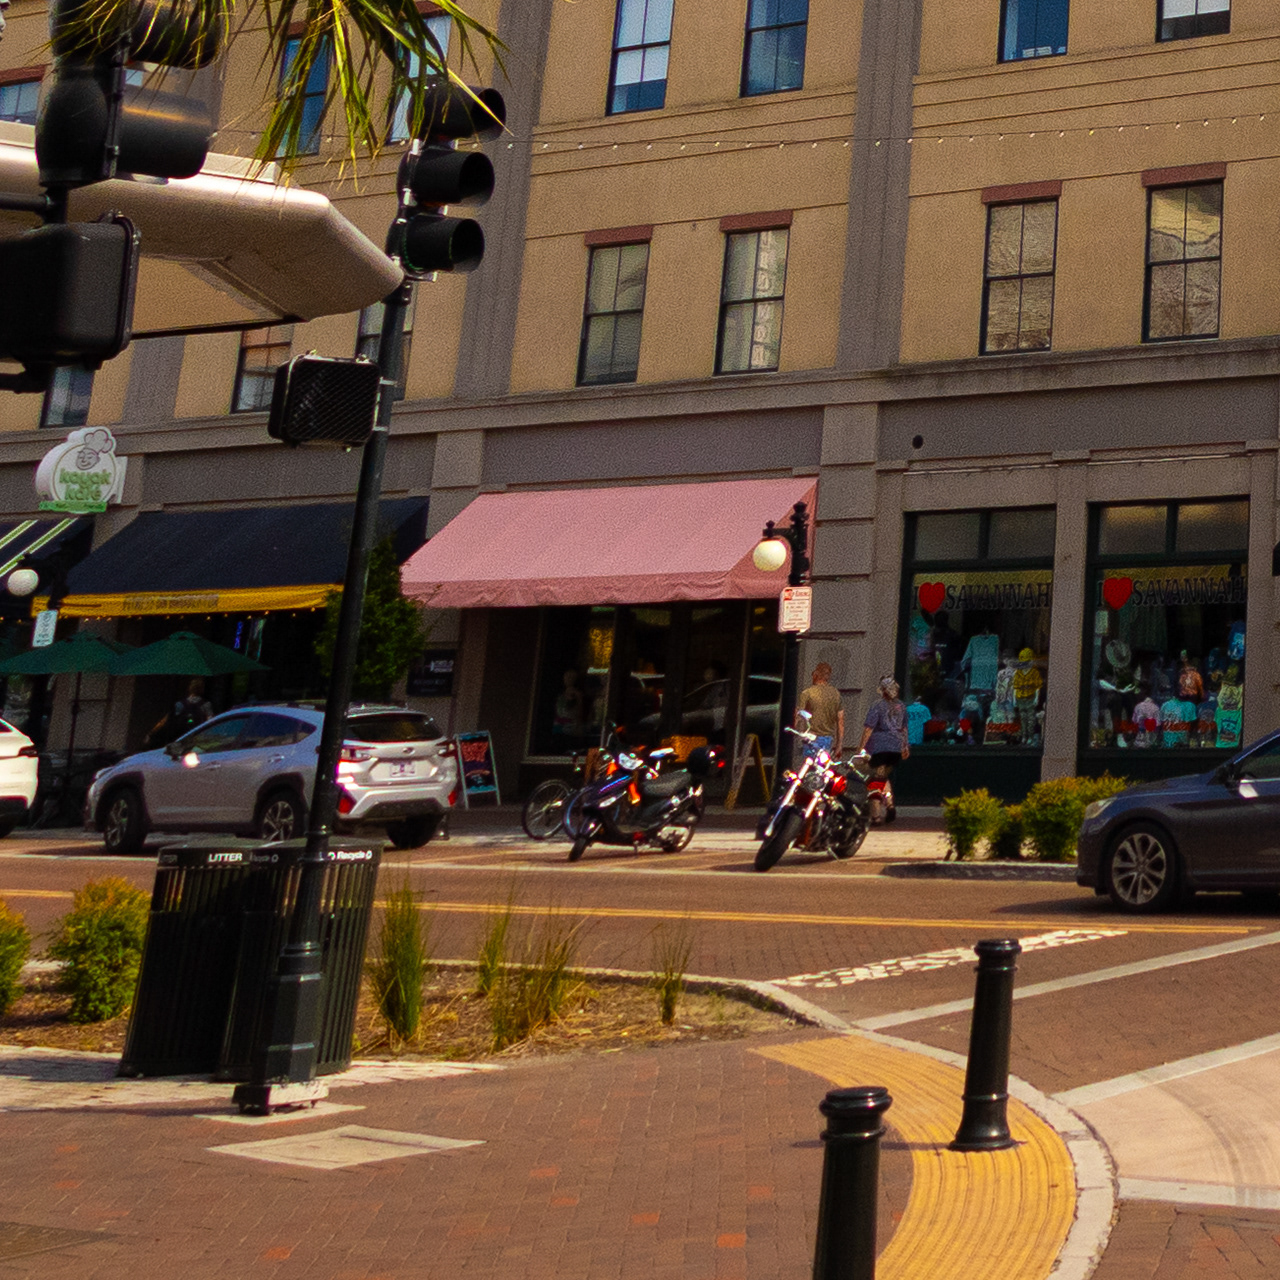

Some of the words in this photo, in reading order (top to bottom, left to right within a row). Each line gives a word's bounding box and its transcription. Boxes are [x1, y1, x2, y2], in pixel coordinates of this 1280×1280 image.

[60, 468, 110, 488] kayak
[946, 582, 1052, 610] SAVANNAH
[1132, 577, 1246, 607] SAVANNAH
[208, 853, 243, 863] LITTER
[336, 850, 365, 861] Recycle
